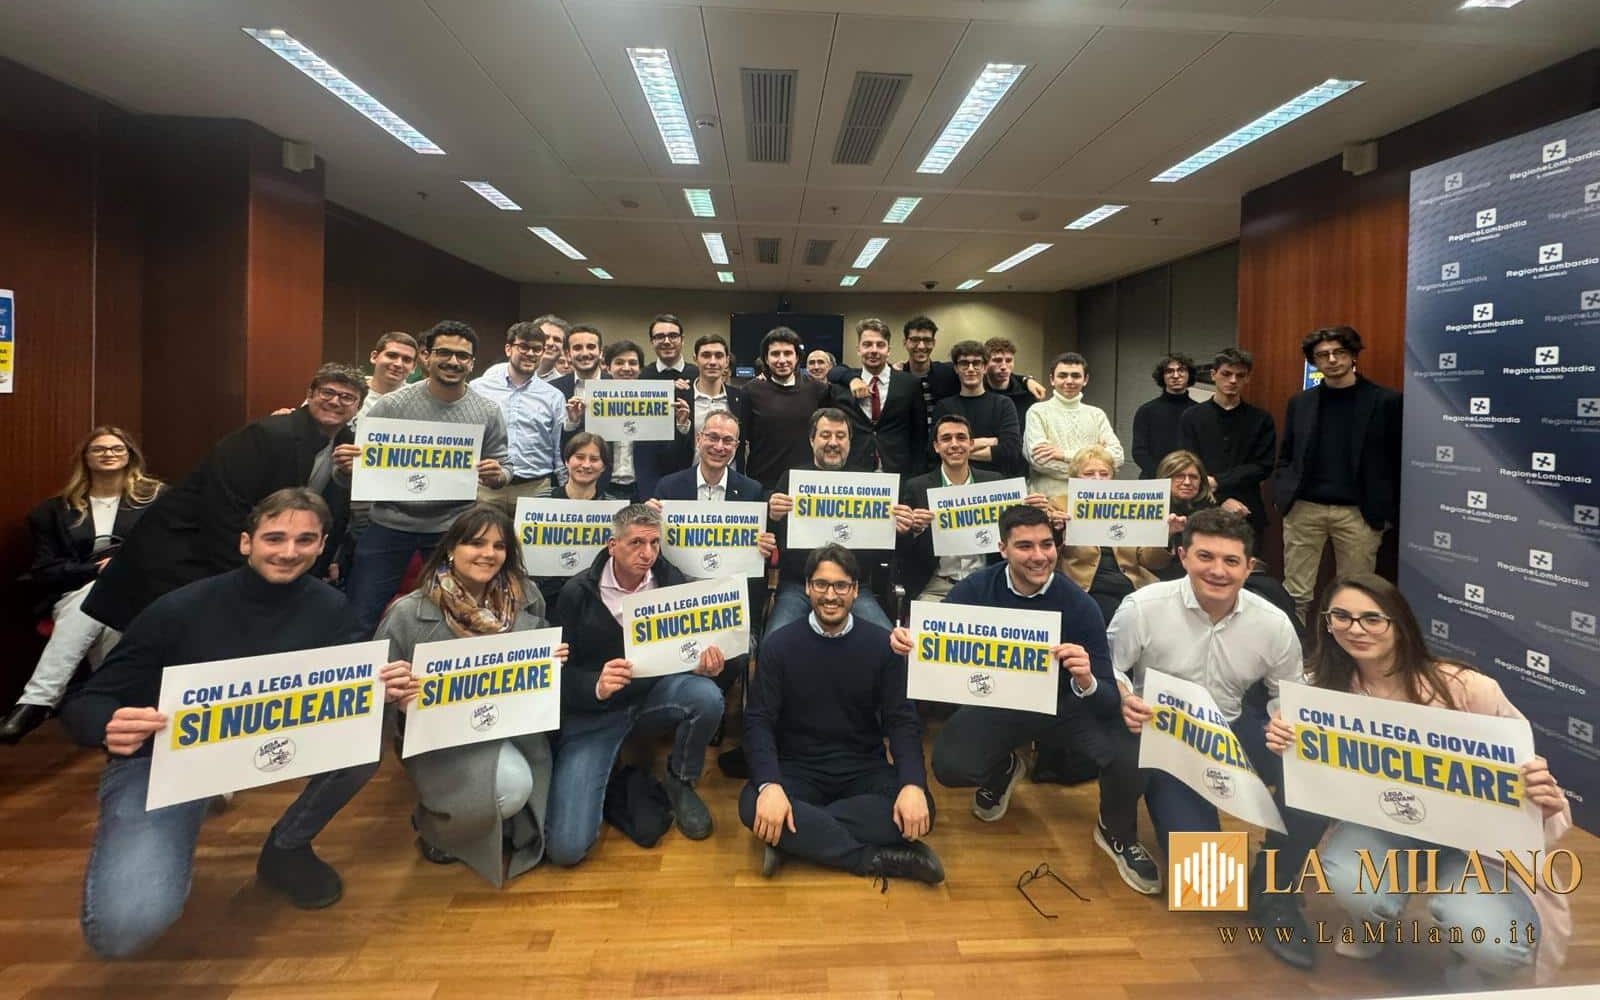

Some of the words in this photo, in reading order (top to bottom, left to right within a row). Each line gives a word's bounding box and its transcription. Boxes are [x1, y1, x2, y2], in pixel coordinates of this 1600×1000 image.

[1448, 219, 1527, 242] RegioneLombardia
[1506, 257, 1600, 278] RegioneLombardia
[1445, 318, 1524, 332] RegioneLombardia
[1503, 365, 1596, 376] RegioneLombardia
[593, 390, 607, 398] CON
[610, 390, 619, 398] LA
[621, 390, 638, 398] LEGA
[640, 390, 668, 398] GIOVANI
[593, 398, 604, 416] SÌ
[608, 401, 669, 417] NUCLEARE
[1443, 414, 1520, 424] RegioneLombardia
[368, 432, 390, 443] CON
[392, 433, 406, 444] LA
[409, 434, 433, 445] LEGA
[437, 436, 474, 447] GIOVANI
[366, 443, 383, 467] SÌ
[387, 447, 473, 469] NUCLEARE
[1499, 468, 1592, 484] RegioneLombardia
[799, 484, 816, 494] CON
[819, 485, 830, 495] LA
[832, 486, 854, 495] LEGA
[857, 487, 891, 496] GIOVANI
[937, 499, 954, 509] CON
[956, 497, 966, 506] LA
[968, 495, 987, 505] LEGA
[989, 491, 1020, 503] GIOVANI
[1077, 491, 1094, 500] CON
[1097, 491, 1107, 500] LA
[1109, 492, 1130, 500] LEGA
[1132, 492, 1164, 500] GIOVANI
[525, 512, 543, 522] CON
[546, 512, 557, 522] LA
[561, 513, 583, 523] LEGA
[586, 514, 616, 523] GIOVA
[798, 494, 811, 517] SÌ
[815, 498, 890, 519] NUCLEARE
[940, 508, 952, 529] SÌ
[956, 505, 1006, 527] NUCLE
[1076, 500, 1089, 519] SÌ
[1092, 503, 1164, 520] NUCLEARE
[1440, 503, 1518, 522] RegioneLombardia
[668, 514, 685, 523] CON
[688, 514, 699, 523] LA
[701, 514, 723, 524] LEGA
[725, 515, 758, 524] GIOVANI
[523, 522, 538, 545] SÌ
[542, 526, 612, 545] NUCLEAR
[667, 524, 680, 546] SÌ
[685, 528, 758, 547] NUCLEARE
[1497, 561, 1590, 588] RegioneLombardia
[634, 605, 655, 618] CON
[658, 602, 671, 613] LA
[673, 598, 699, 609] LEGA
[702, 590, 740, 606] GIOVANI
[1437, 593, 1514, 621] RegioneLombardia
[635, 616, 652, 643] SÌ
[656, 605, 742, 640] NUCLEARE
[923, 619, 946, 633] CON
[950, 622, 964, 635] LA
[968, 623, 997, 637] LEGA
[1001, 627, 1049, 642] GIOVANI
[426, 660, 452, 674] CON
[455, 656, 471, 669] LA
[475, 653, 504, 667] LEGA
[507, 646, 551, 662] GIOVANI
[922, 632, 939, 661] SÌ
[945, 639, 1050, 672] NUCLEARE
[183, 686, 223, 705] CON
[228, 681, 252, 698] LA
[258, 674, 303, 693] LEGA
[308, 664, 372, 686] GIOVANI
[422, 672, 443, 706] SÌ
[448, 664, 551, 702] NUCLEARE
[1494, 657, 1586, 695] RegioneLombardia
[178, 703, 212, 746] SÌ
[219, 684, 372, 739] NUCLEARE
[1157, 692, 1184, 710] CON
[1188, 705, 1204, 721] LA
[1155, 707, 1177, 736] SÌ
[1300, 707, 1335, 728] CON
[1341, 715, 1364, 734] LA
[1370, 720, 1421, 744] LEGA
[1427, 731, 1516, 764] GIOVANI
[1301, 726, 1329, 763] SÌ
[1337, 736, 1521, 807] NUCLEARE
